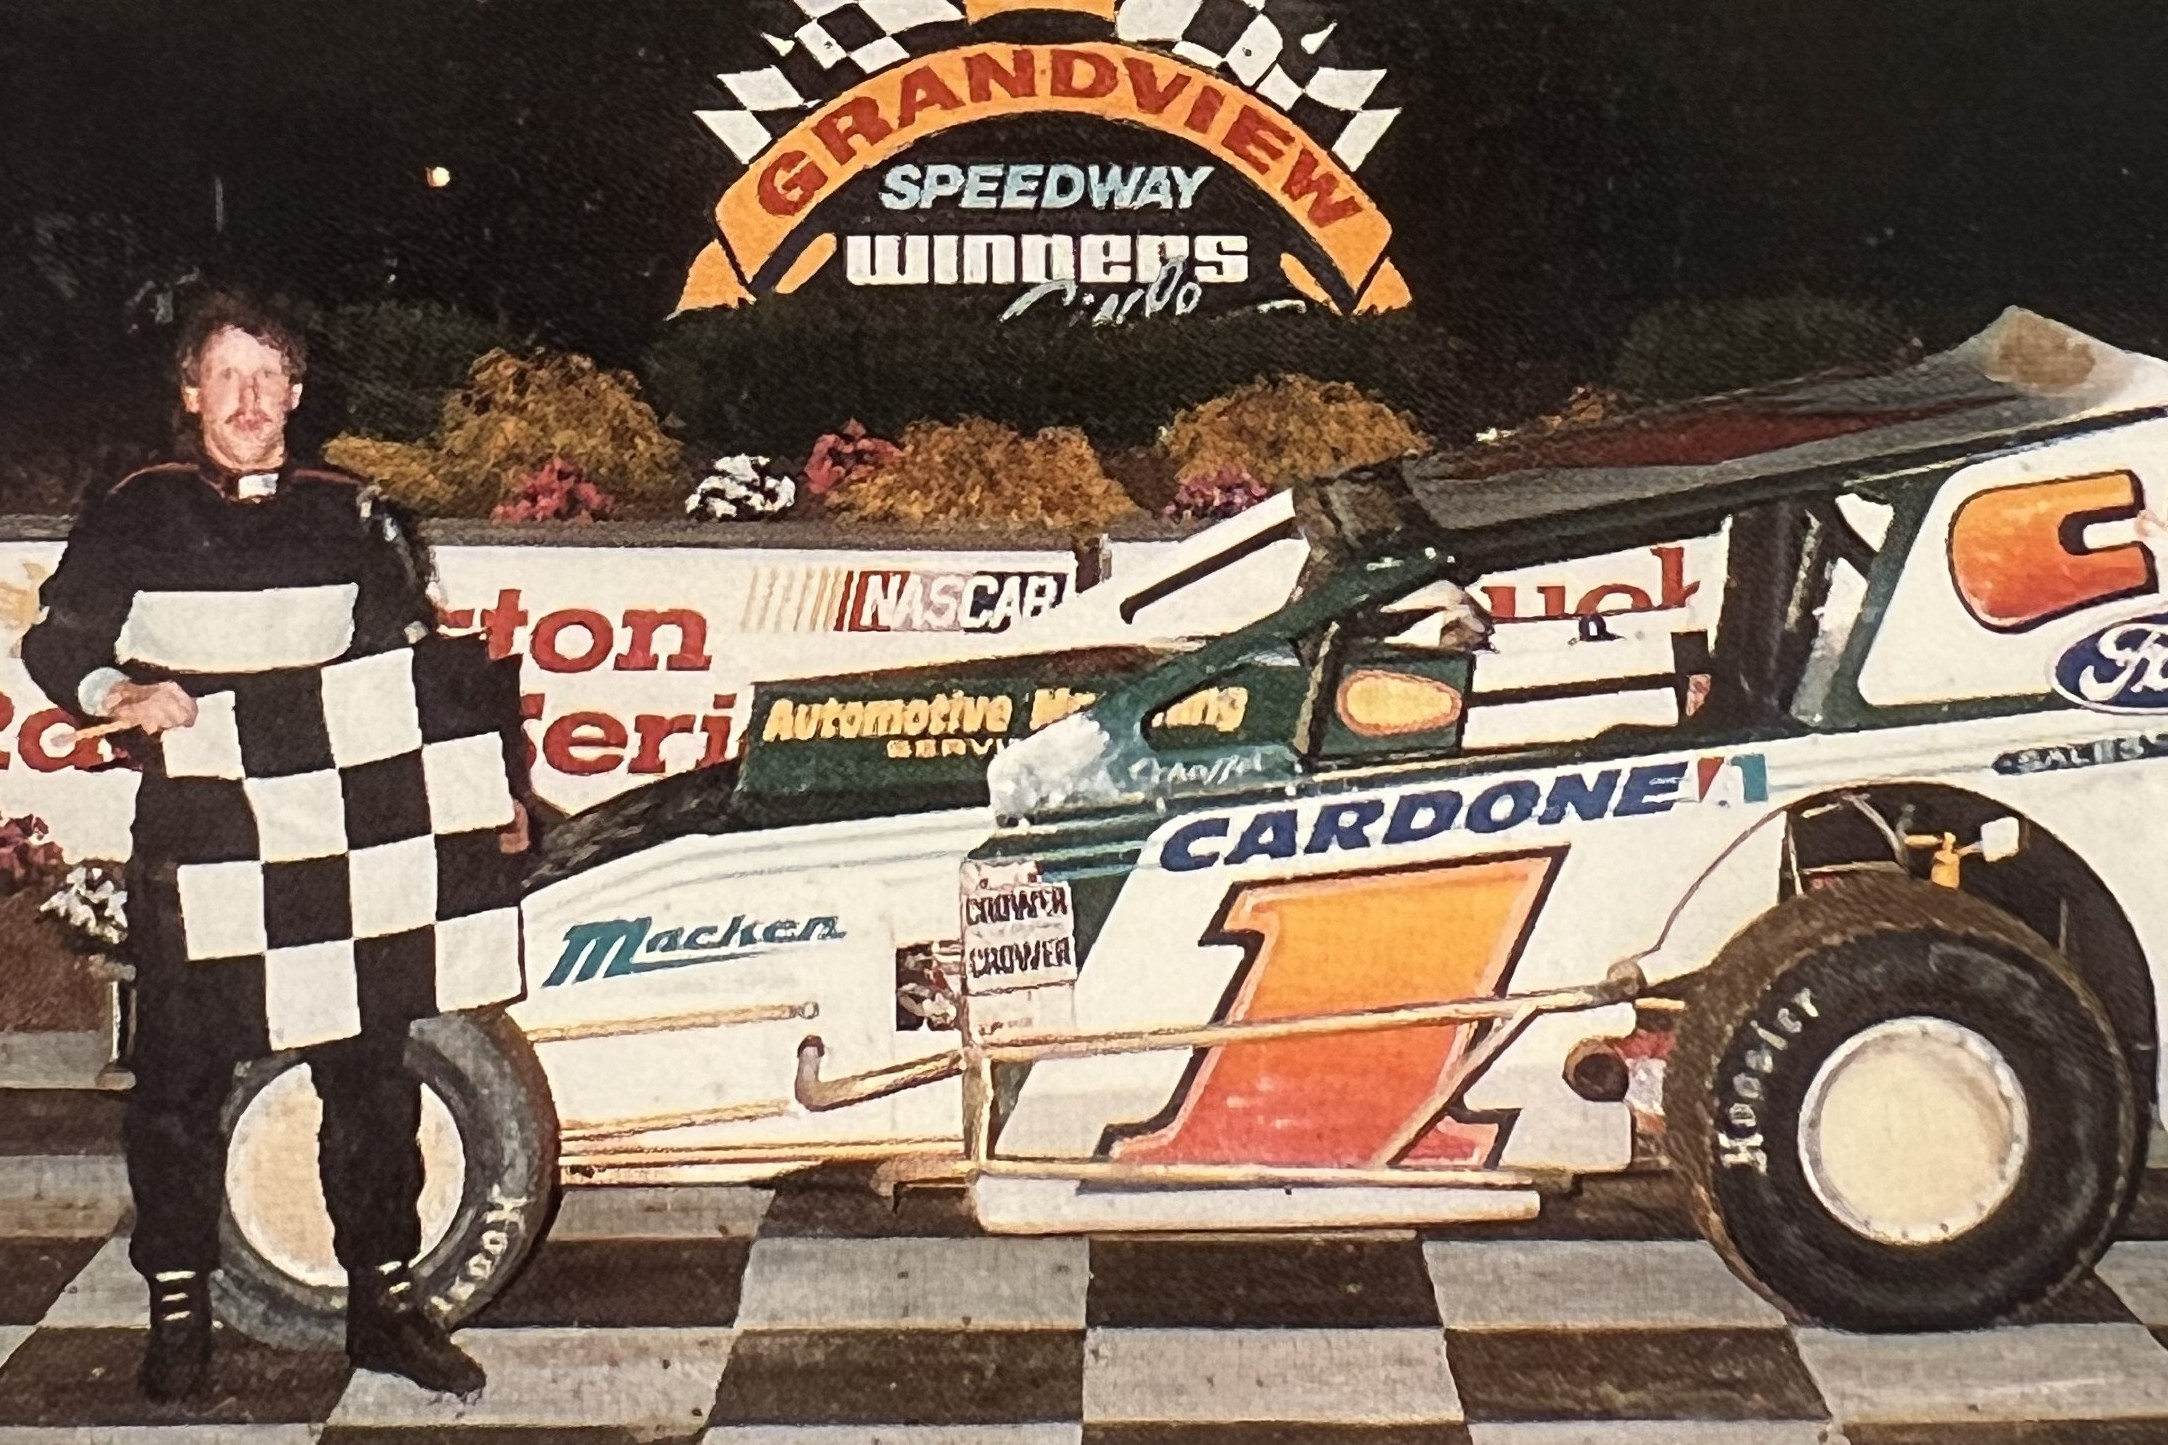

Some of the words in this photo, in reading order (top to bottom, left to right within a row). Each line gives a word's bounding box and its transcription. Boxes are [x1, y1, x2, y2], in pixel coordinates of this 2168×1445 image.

[757, 47, 1363, 230] GRANDVIEW
[877, 163, 1217, 210] SPEEDWAY
[857, 571, 1065, 632] NASCAR
[762, 689, 1013, 742] Automotive
[1160, 761, 1690, 872] CARDONE
[969, 936, 1072, 978] CROWER
